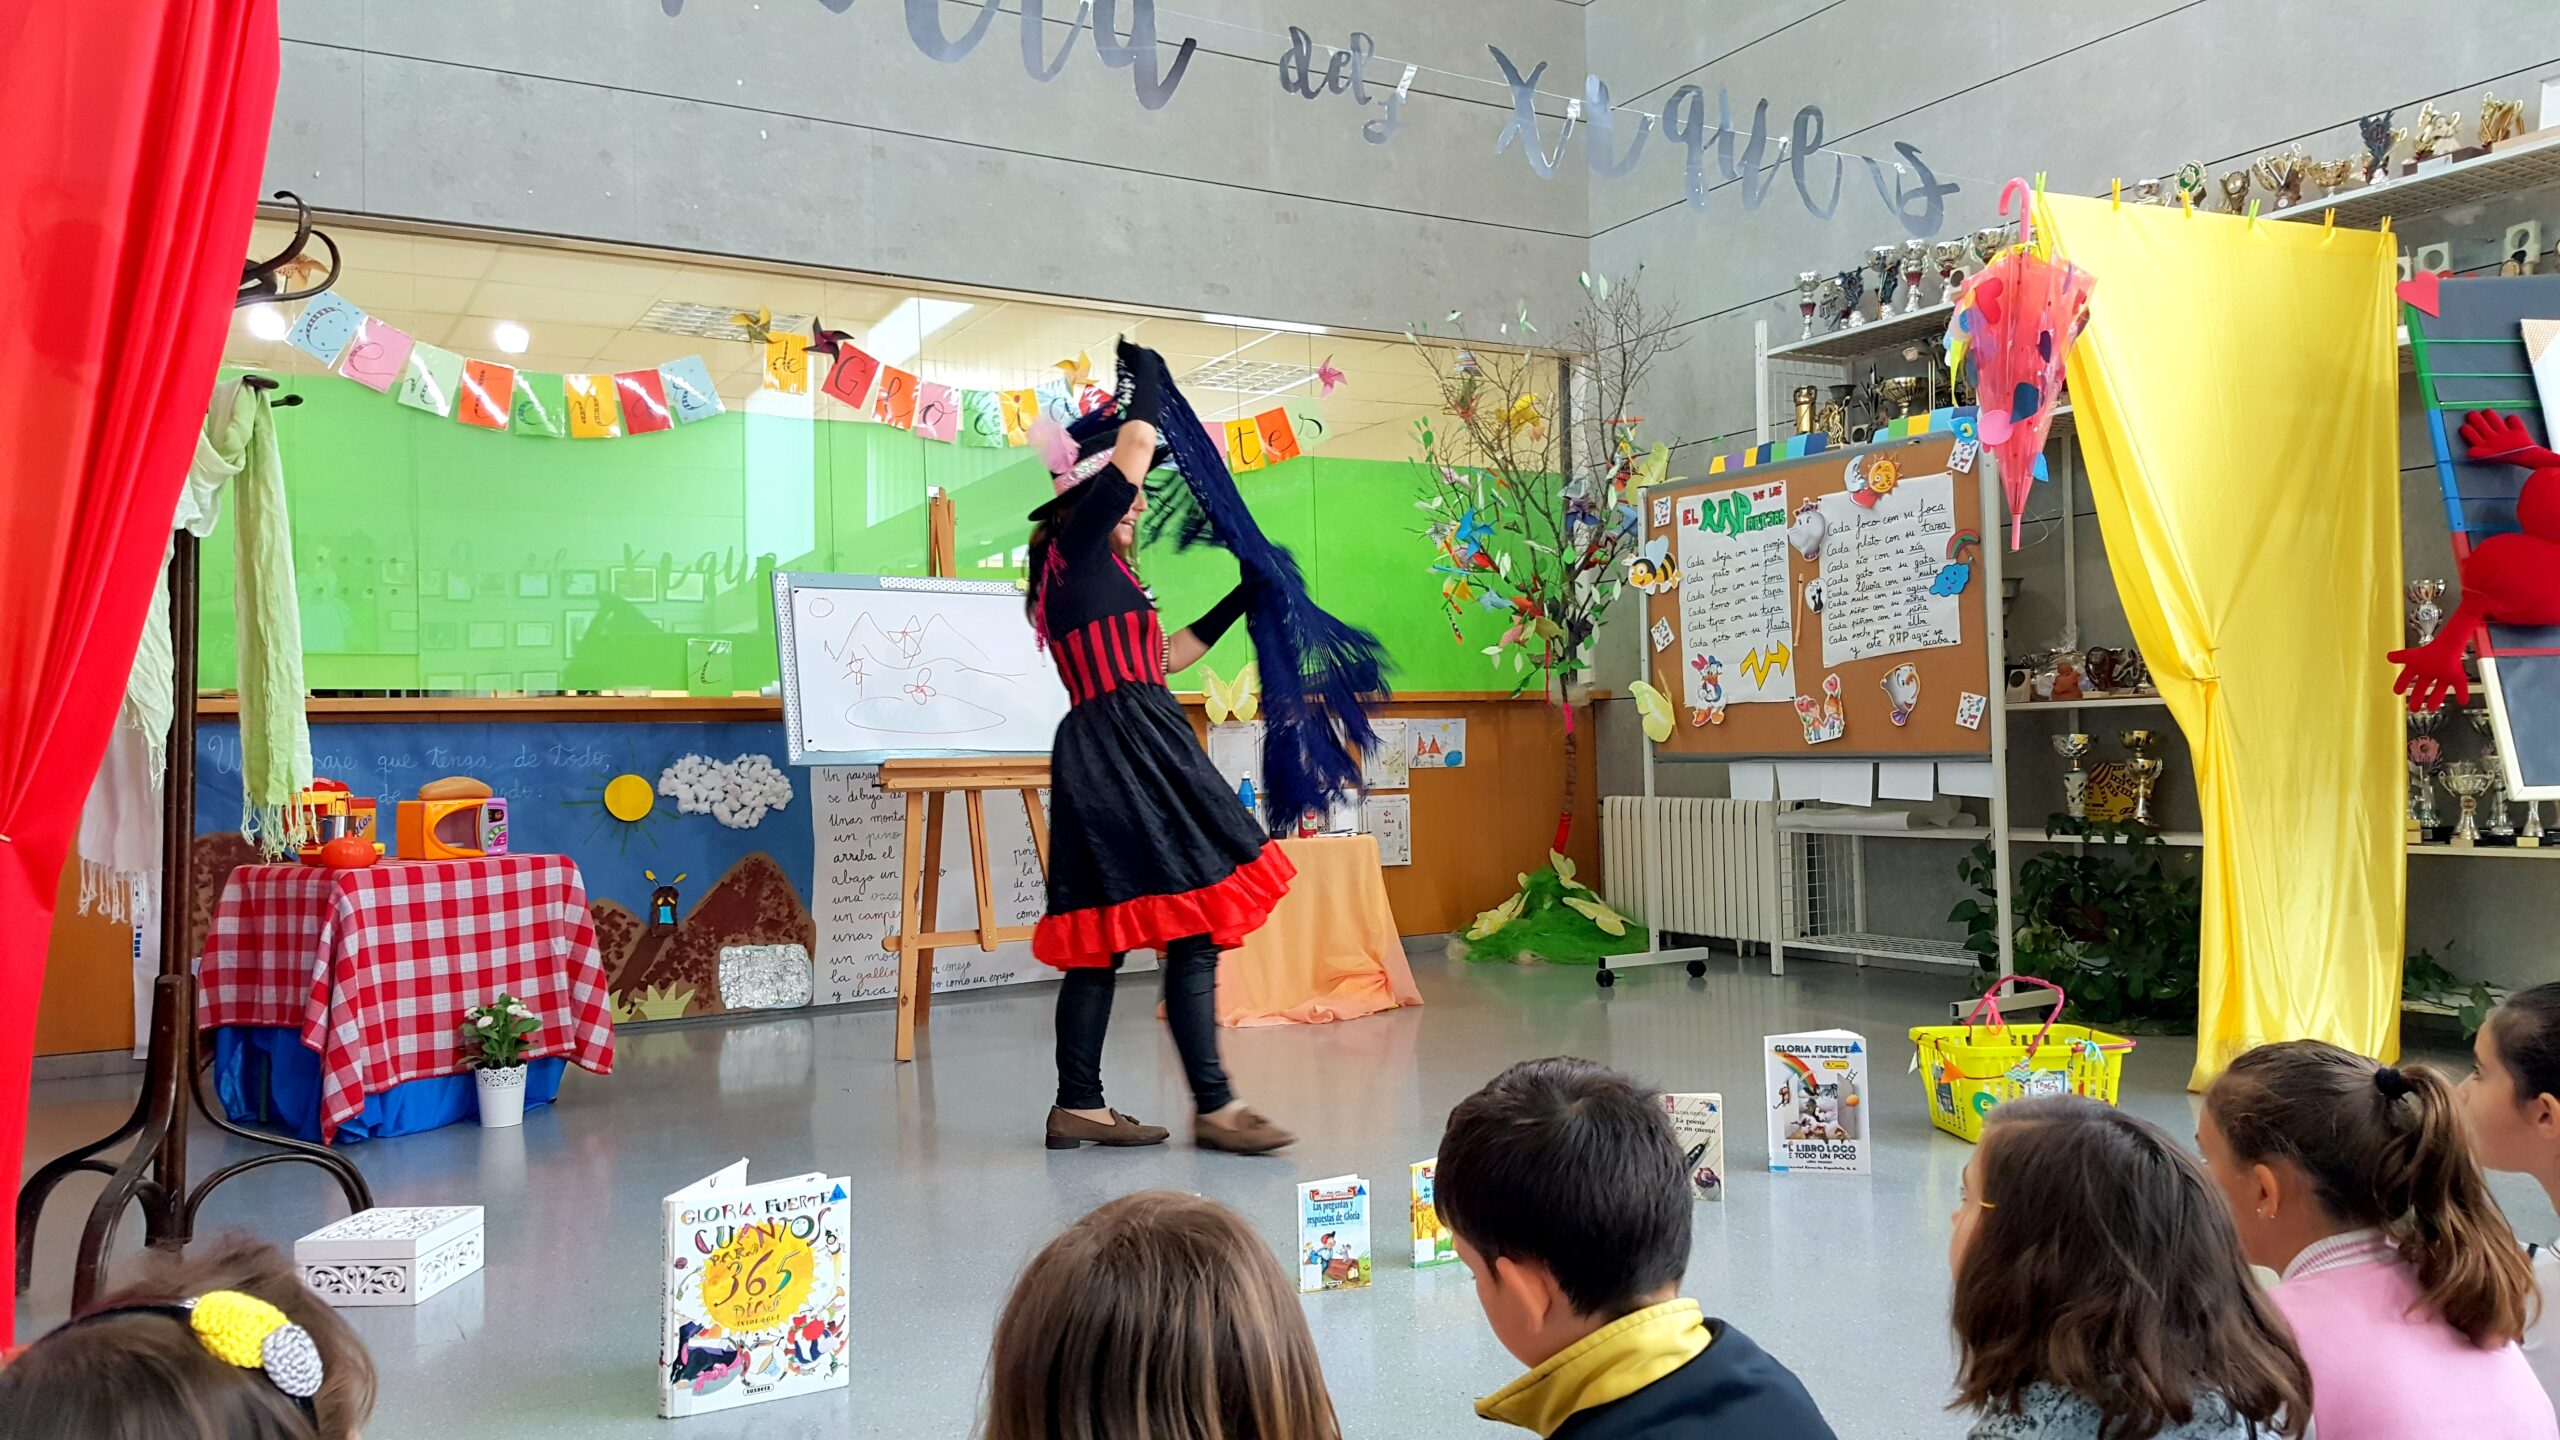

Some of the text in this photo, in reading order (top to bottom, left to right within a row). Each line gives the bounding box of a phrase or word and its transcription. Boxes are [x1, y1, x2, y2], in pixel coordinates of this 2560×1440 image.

[1683, 508, 1698, 526] EL
[1698, 490, 1752, 542] RAP
[1827, 521, 1851, 537] Cada
[1883, 515, 1899, 524] con
[1904, 511, 1914, 519] su
[1917, 498, 1945, 523] foca
[1827, 542, 1850, 556] Cada
[1856, 534, 1881, 556] plato
[1885, 535, 1900, 543] con
[1905, 530, 1915, 539] su
[1687, 555, 1705, 568] Cada
[1712, 551, 1732, 566] abeja
[1827, 559, 1849, 573] Cada
[1874, 552, 1890, 560] con
[1687, 572, 1704, 584] Cada
[1712, 567, 1730, 585] pato
[1827, 574, 1849, 587] Cada
[1855, 567, 1874, 584] gato
[1914, 553, 1936, 572] gata
[1686, 588, 1705, 602] Cada
[1710, 584, 1728, 596] loco
[1827, 586, 1849, 599] Cada
[1828, 598, 1847, 609] Cada
[1906, 585, 1928, 596] agua
[1688, 605, 1706, 617] Cada
[1688, 621, 1706, 632] Cada
[1828, 621, 1847, 632] Cada
[1689, 637, 1708, 648] Cada
[1828, 635, 1847, 645] Cada
[1866, 635, 1882, 649] este
[1889, 631, 1909, 647] RAP
[208, 735, 242, 775] U
[377, 755, 417, 787] que
[514, 745, 542, 768] de
[823, 768, 840, 781] Un
[828, 787, 882, 809] se dibuja
[829, 814, 863, 826] Unas
[834, 832, 903, 848] un pino
[834, 845, 895, 863] arriba el
[831, 869, 899, 895] abajo un
[1013, 878, 1024, 888] de
[832, 895, 863, 904] una
[832, 913, 854, 923] un
[832, 932, 873, 943] unas
[830, 955, 855, 965] un
[830, 962, 971, 990] la gallin conejo
[946, 978, 970, 987] como
[973, 976, 986, 984] un
[989, 972, 1015, 987] espejo
[1774, 1044, 1850, 1053] GLORIA FUERTE
[1796, 1144, 1856, 1153] LIBRO LOCO
[681, 1191, 832, 1226] GLORIA FUERTE
[1313, 1201, 1354, 1213] Las preguntas y
[1307, 1214, 1334, 1227] respuestas
[1336, 1212, 1342, 1221] de
[1344, 1211, 1360, 1220] Gloria
[694, 1207, 831, 1255] CUENTOS
[709, 1243, 758, 1266] PARA
[714, 1249, 800, 1307] 365
